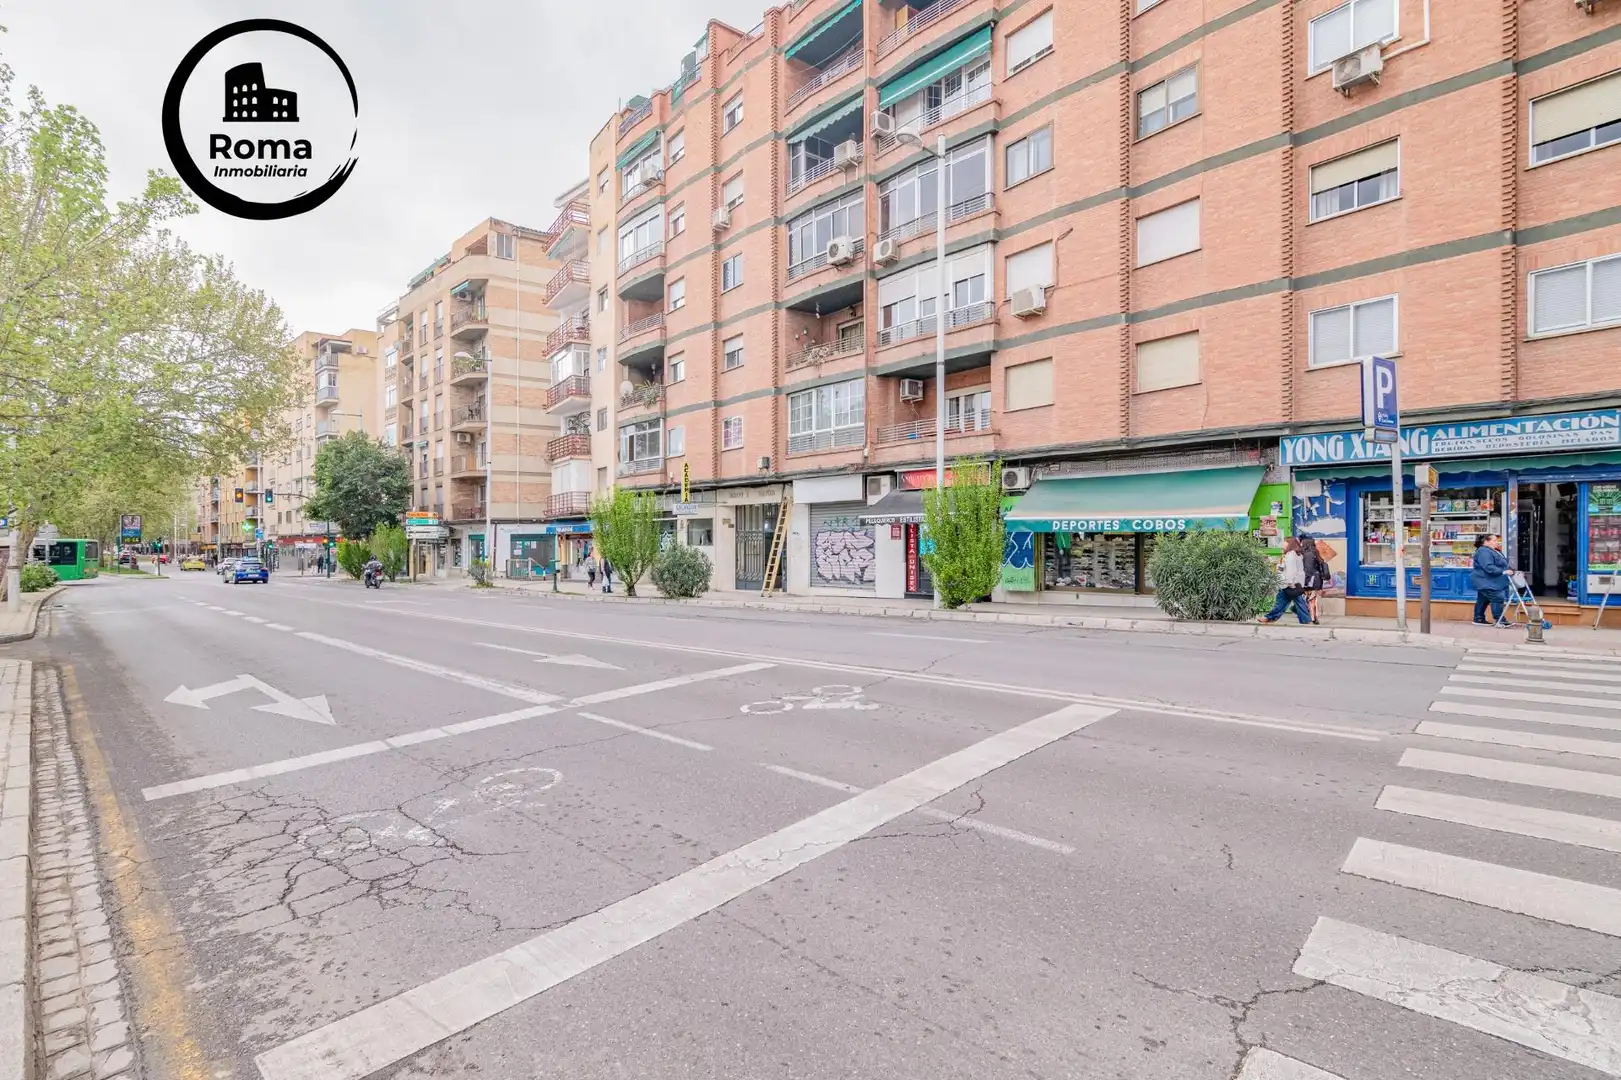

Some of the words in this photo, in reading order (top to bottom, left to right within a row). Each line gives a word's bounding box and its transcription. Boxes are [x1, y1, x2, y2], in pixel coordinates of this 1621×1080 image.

[1376, 365, 1393, 409] P
[1432, 413, 1620, 440] ALIMENTACIÓN
[1283, 434, 1344, 464] YONG
[1052, 520, 1120, 531] DEPORTES
[1132, 519, 1186, 530] COBOS
